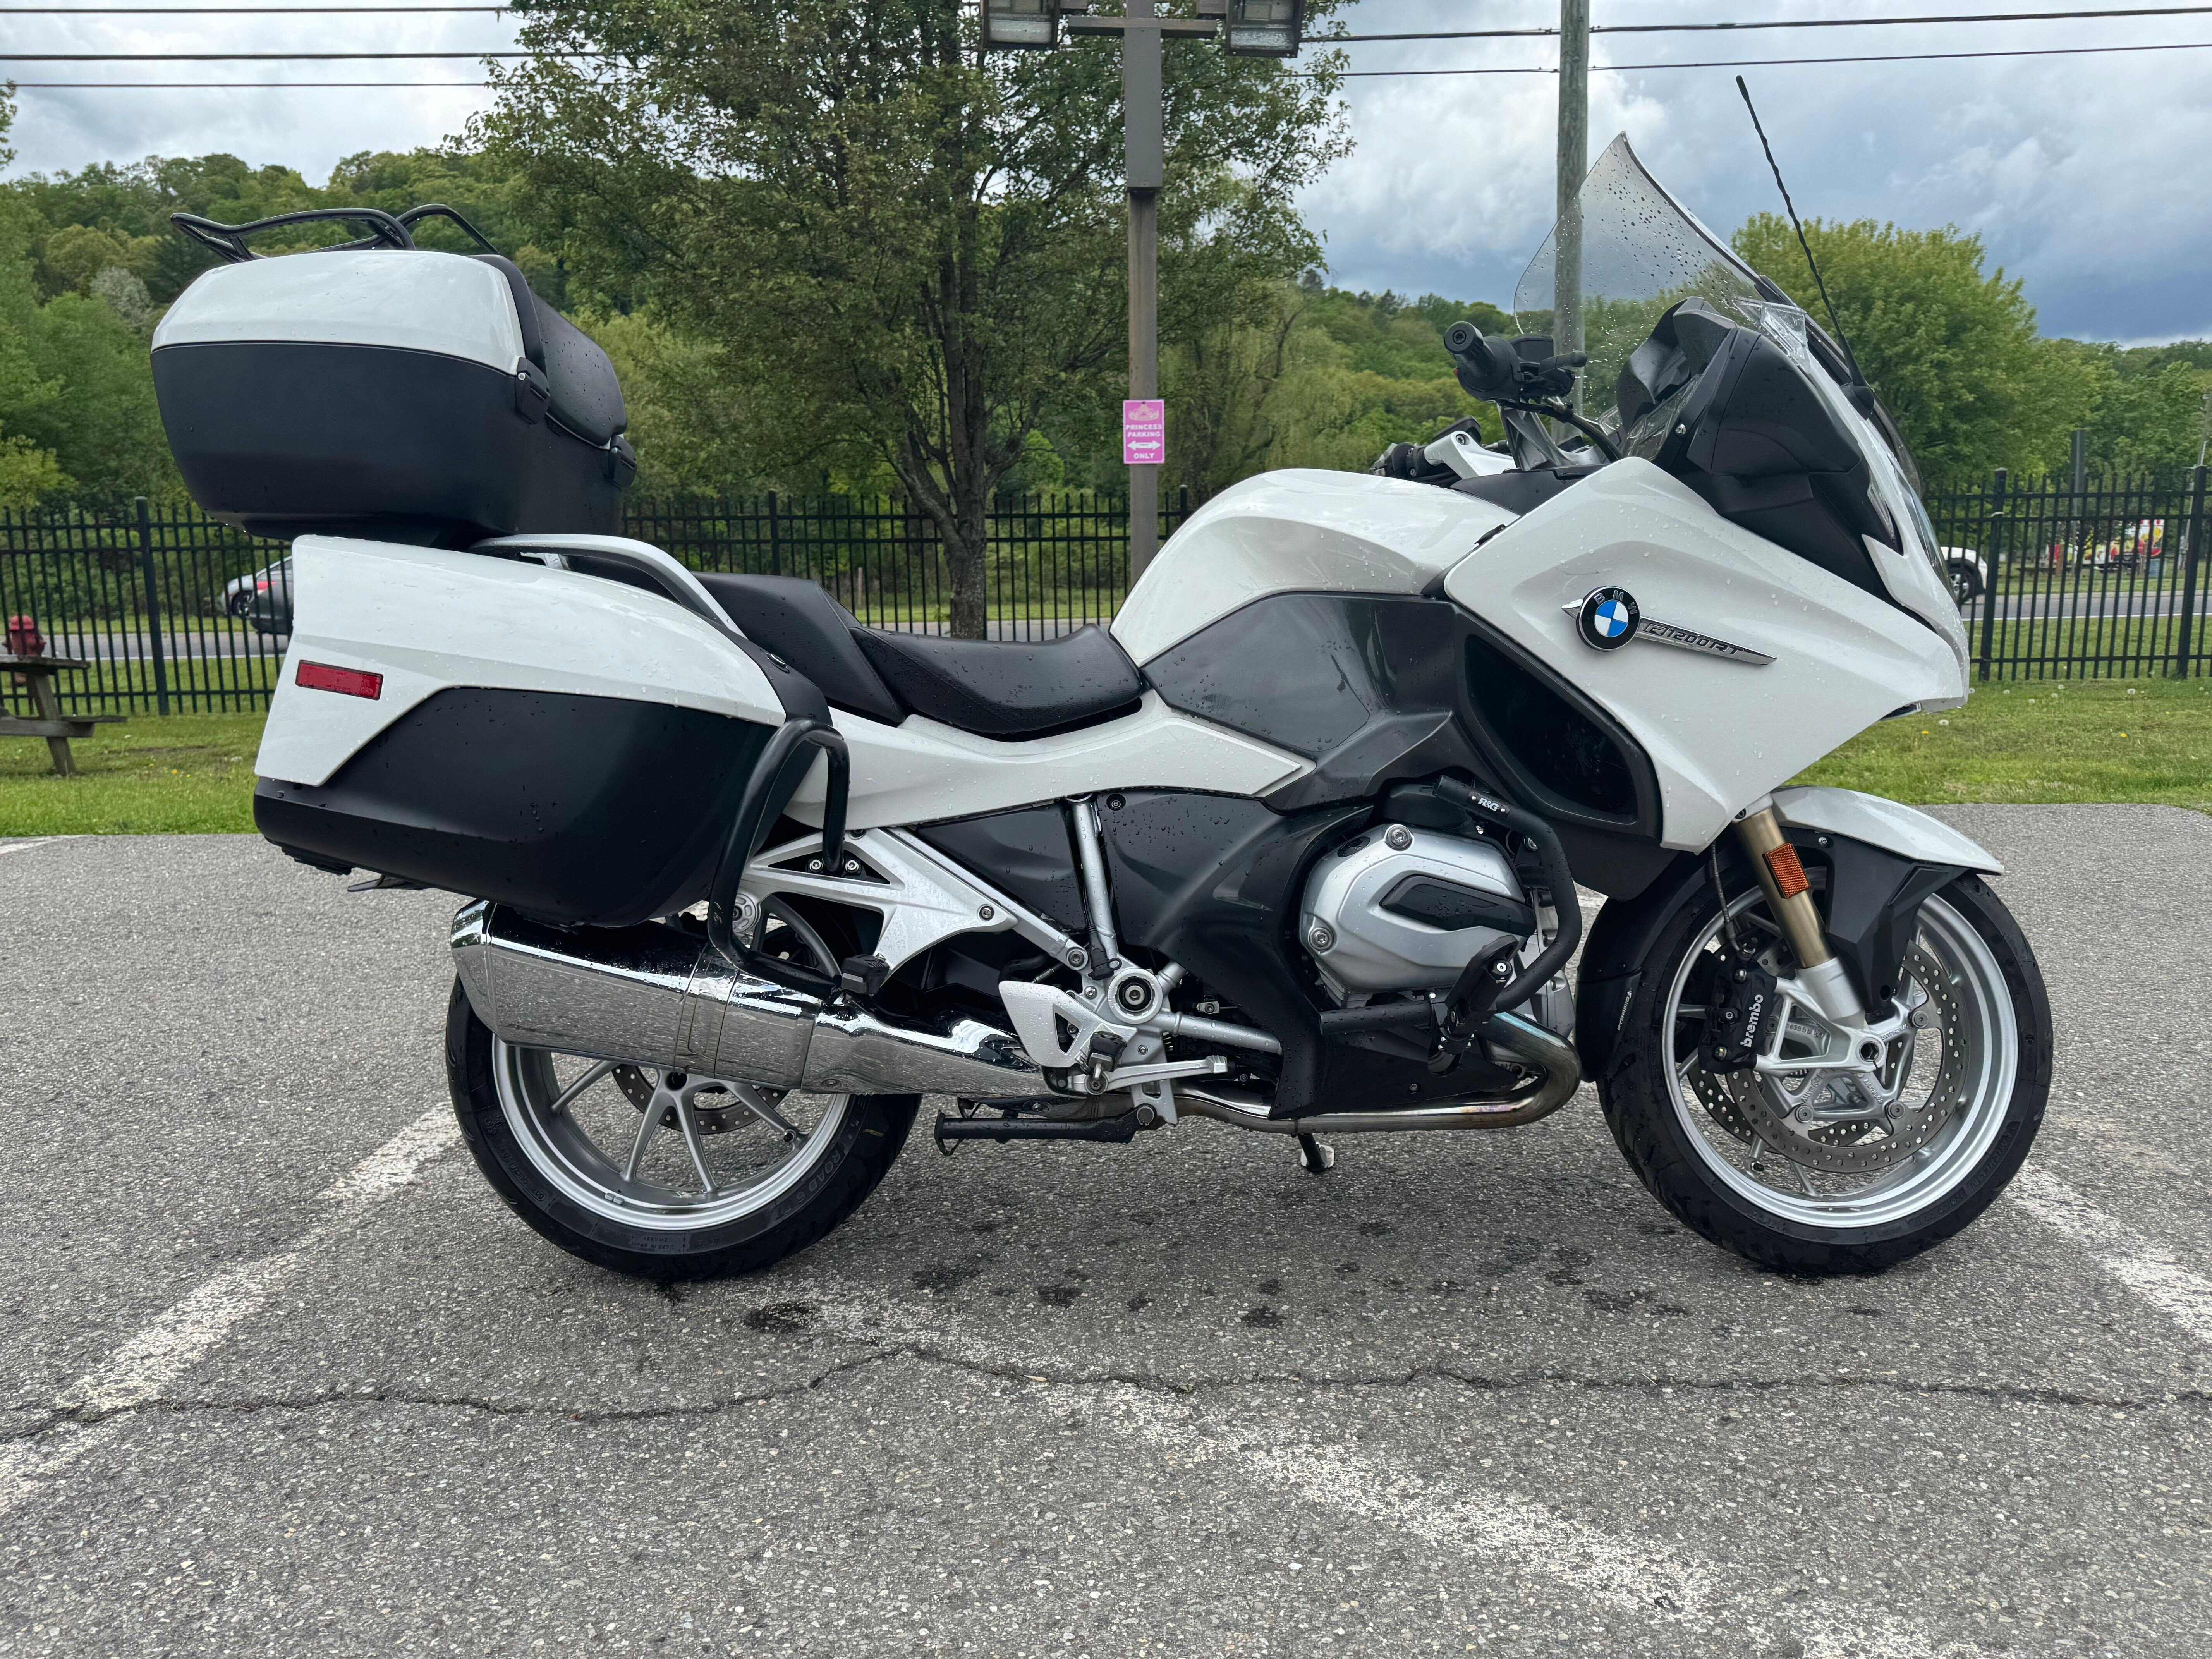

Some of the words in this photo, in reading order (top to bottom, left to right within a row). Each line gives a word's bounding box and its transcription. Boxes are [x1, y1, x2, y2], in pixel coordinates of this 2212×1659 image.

[1594, 590, 1638, 615] BMW
[1478, 797, 1499, 812] R&G
[1617, 996, 1630, 1031] PYRAMID
[1740, 994, 1763, 1047] brembo
[809, 1150, 841, 1192] ROAD
[1970, 1139, 2008, 1190] MICHELIN
[797, 1191, 805, 1203] 6
